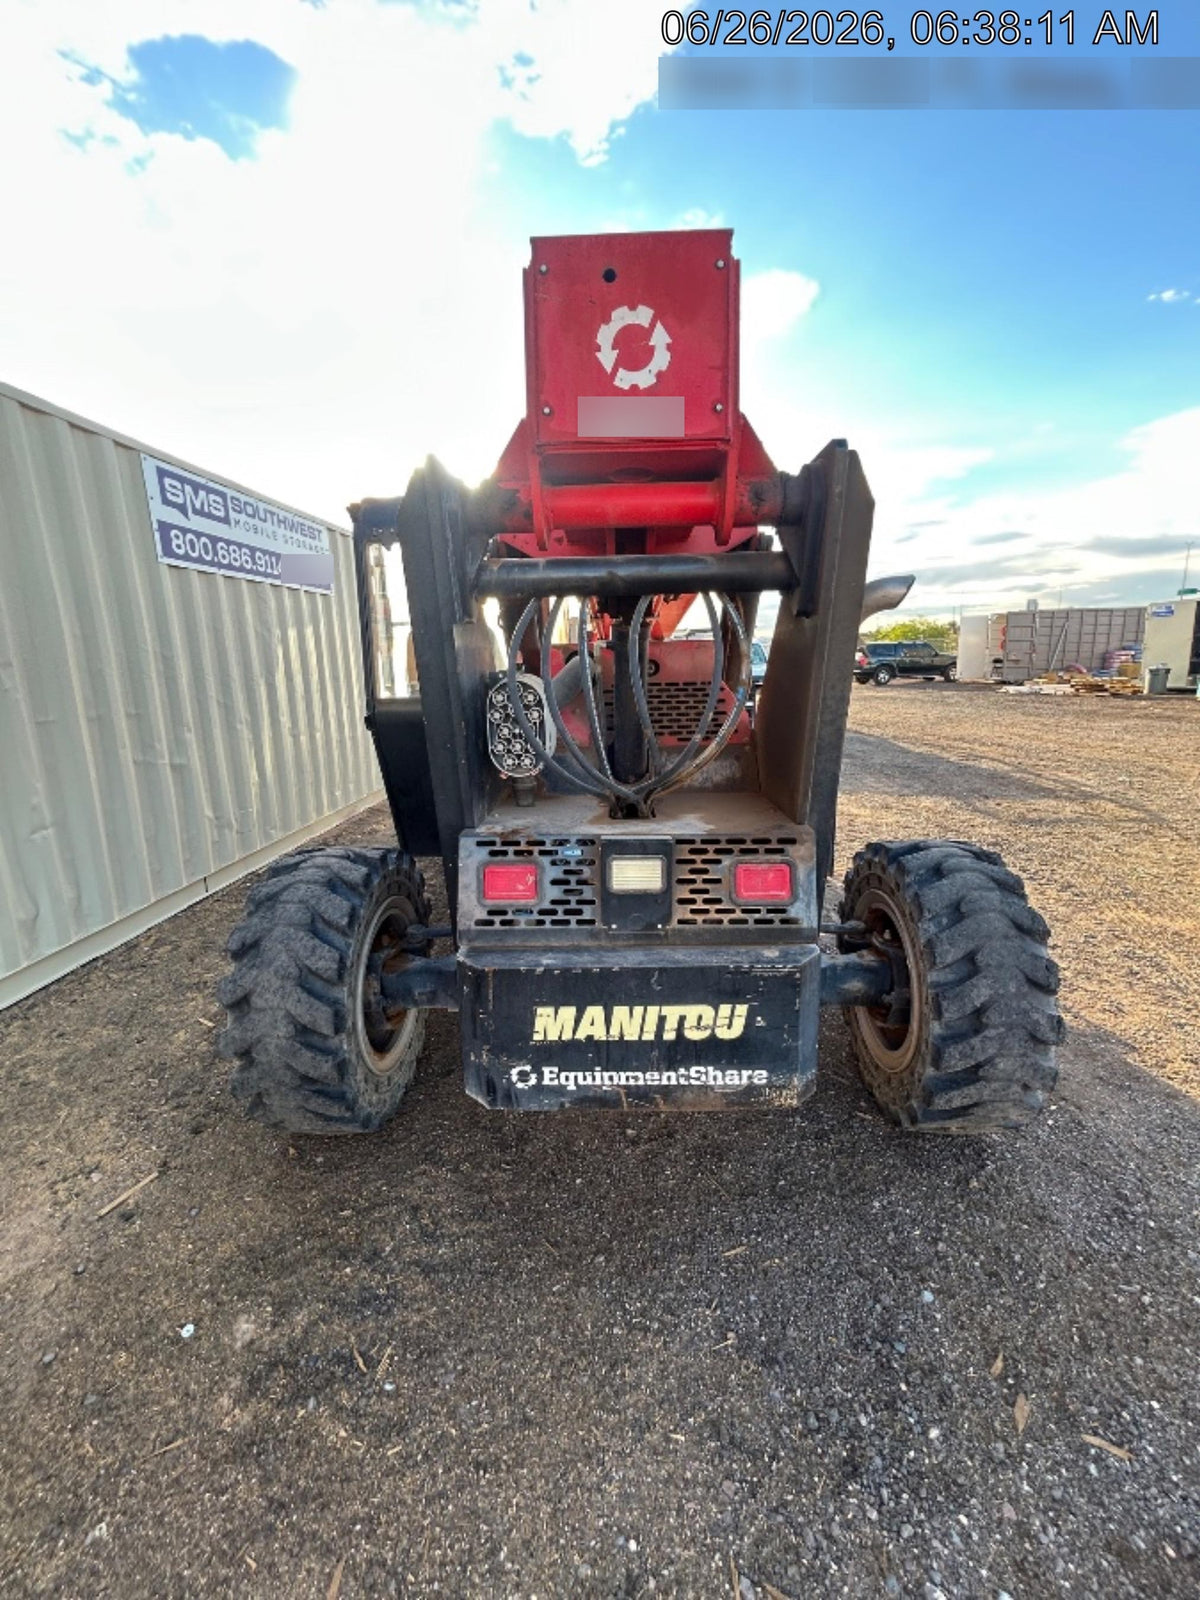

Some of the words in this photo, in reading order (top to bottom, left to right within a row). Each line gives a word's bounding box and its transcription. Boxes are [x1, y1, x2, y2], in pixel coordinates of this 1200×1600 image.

[163, 477, 225, 518] SMS
[230, 495, 323, 541] SOUTHWEST
[233, 518, 278, 541] MOBILE
[532, 1004, 749, 1041] MANITOU
